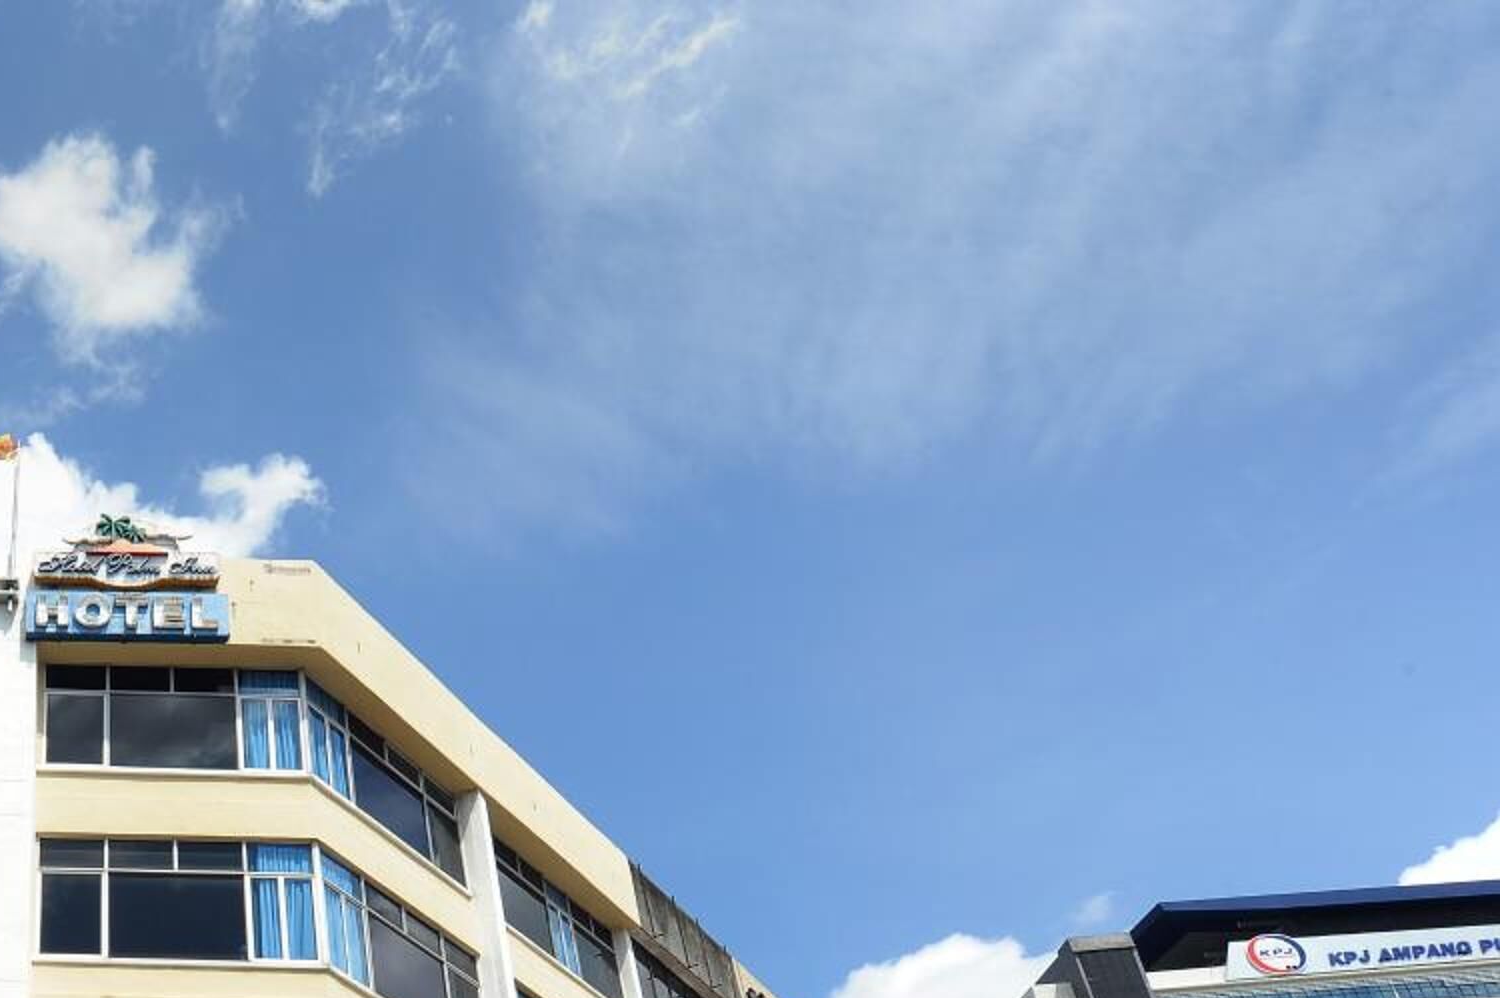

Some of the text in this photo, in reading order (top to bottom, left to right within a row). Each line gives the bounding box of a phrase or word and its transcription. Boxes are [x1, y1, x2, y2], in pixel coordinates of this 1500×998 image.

[35, 594, 219, 630] HOTEL
[1259, 948, 1293, 957] KPJ
[1328, 949, 1371, 967] KPJ
[1378, 940, 1471, 965] AMPANG
